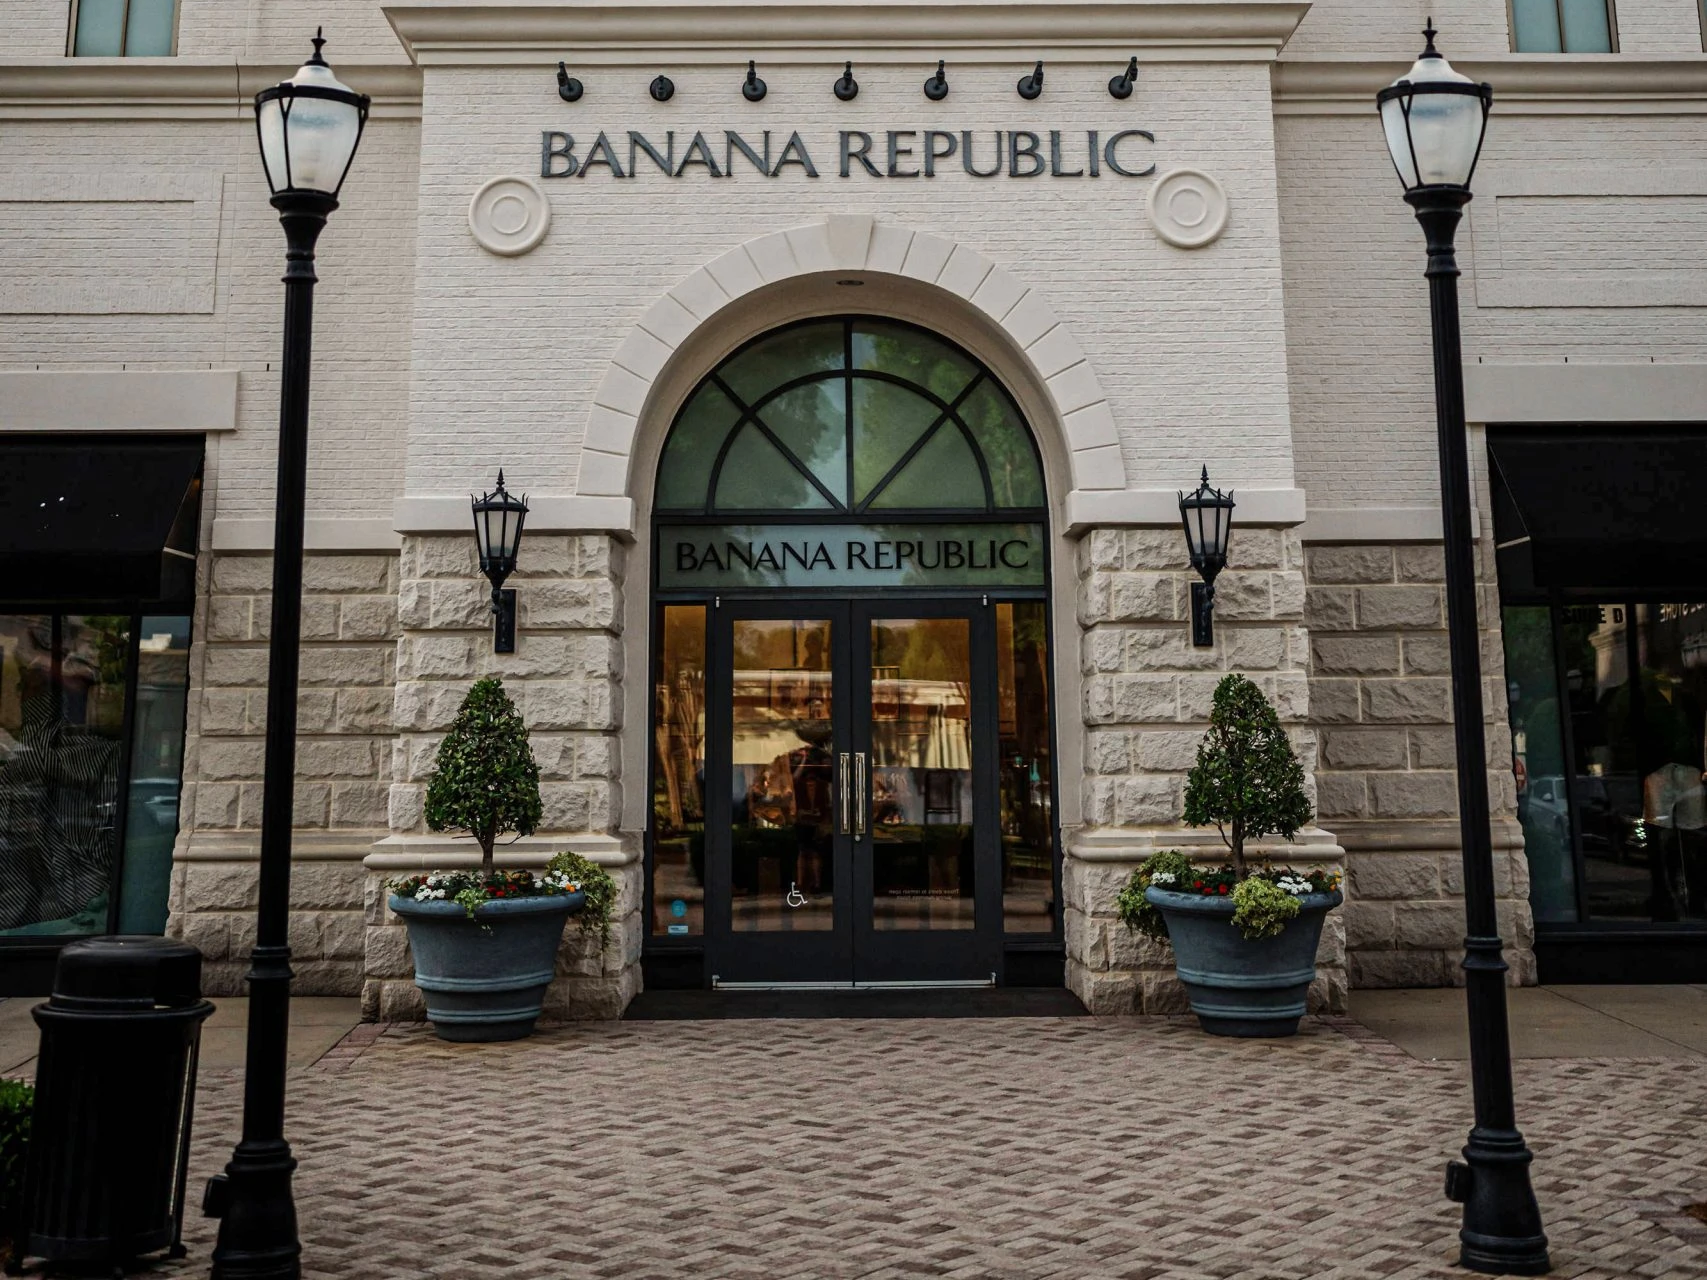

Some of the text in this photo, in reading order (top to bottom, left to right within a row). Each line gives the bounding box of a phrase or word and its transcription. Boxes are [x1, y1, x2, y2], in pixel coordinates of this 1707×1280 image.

[541, 130, 1155, 179] BANANA REPUBLIC
[676, 540, 1029, 571] BANANA REPUBLIC
[1613, 608, 1624, 624] D
